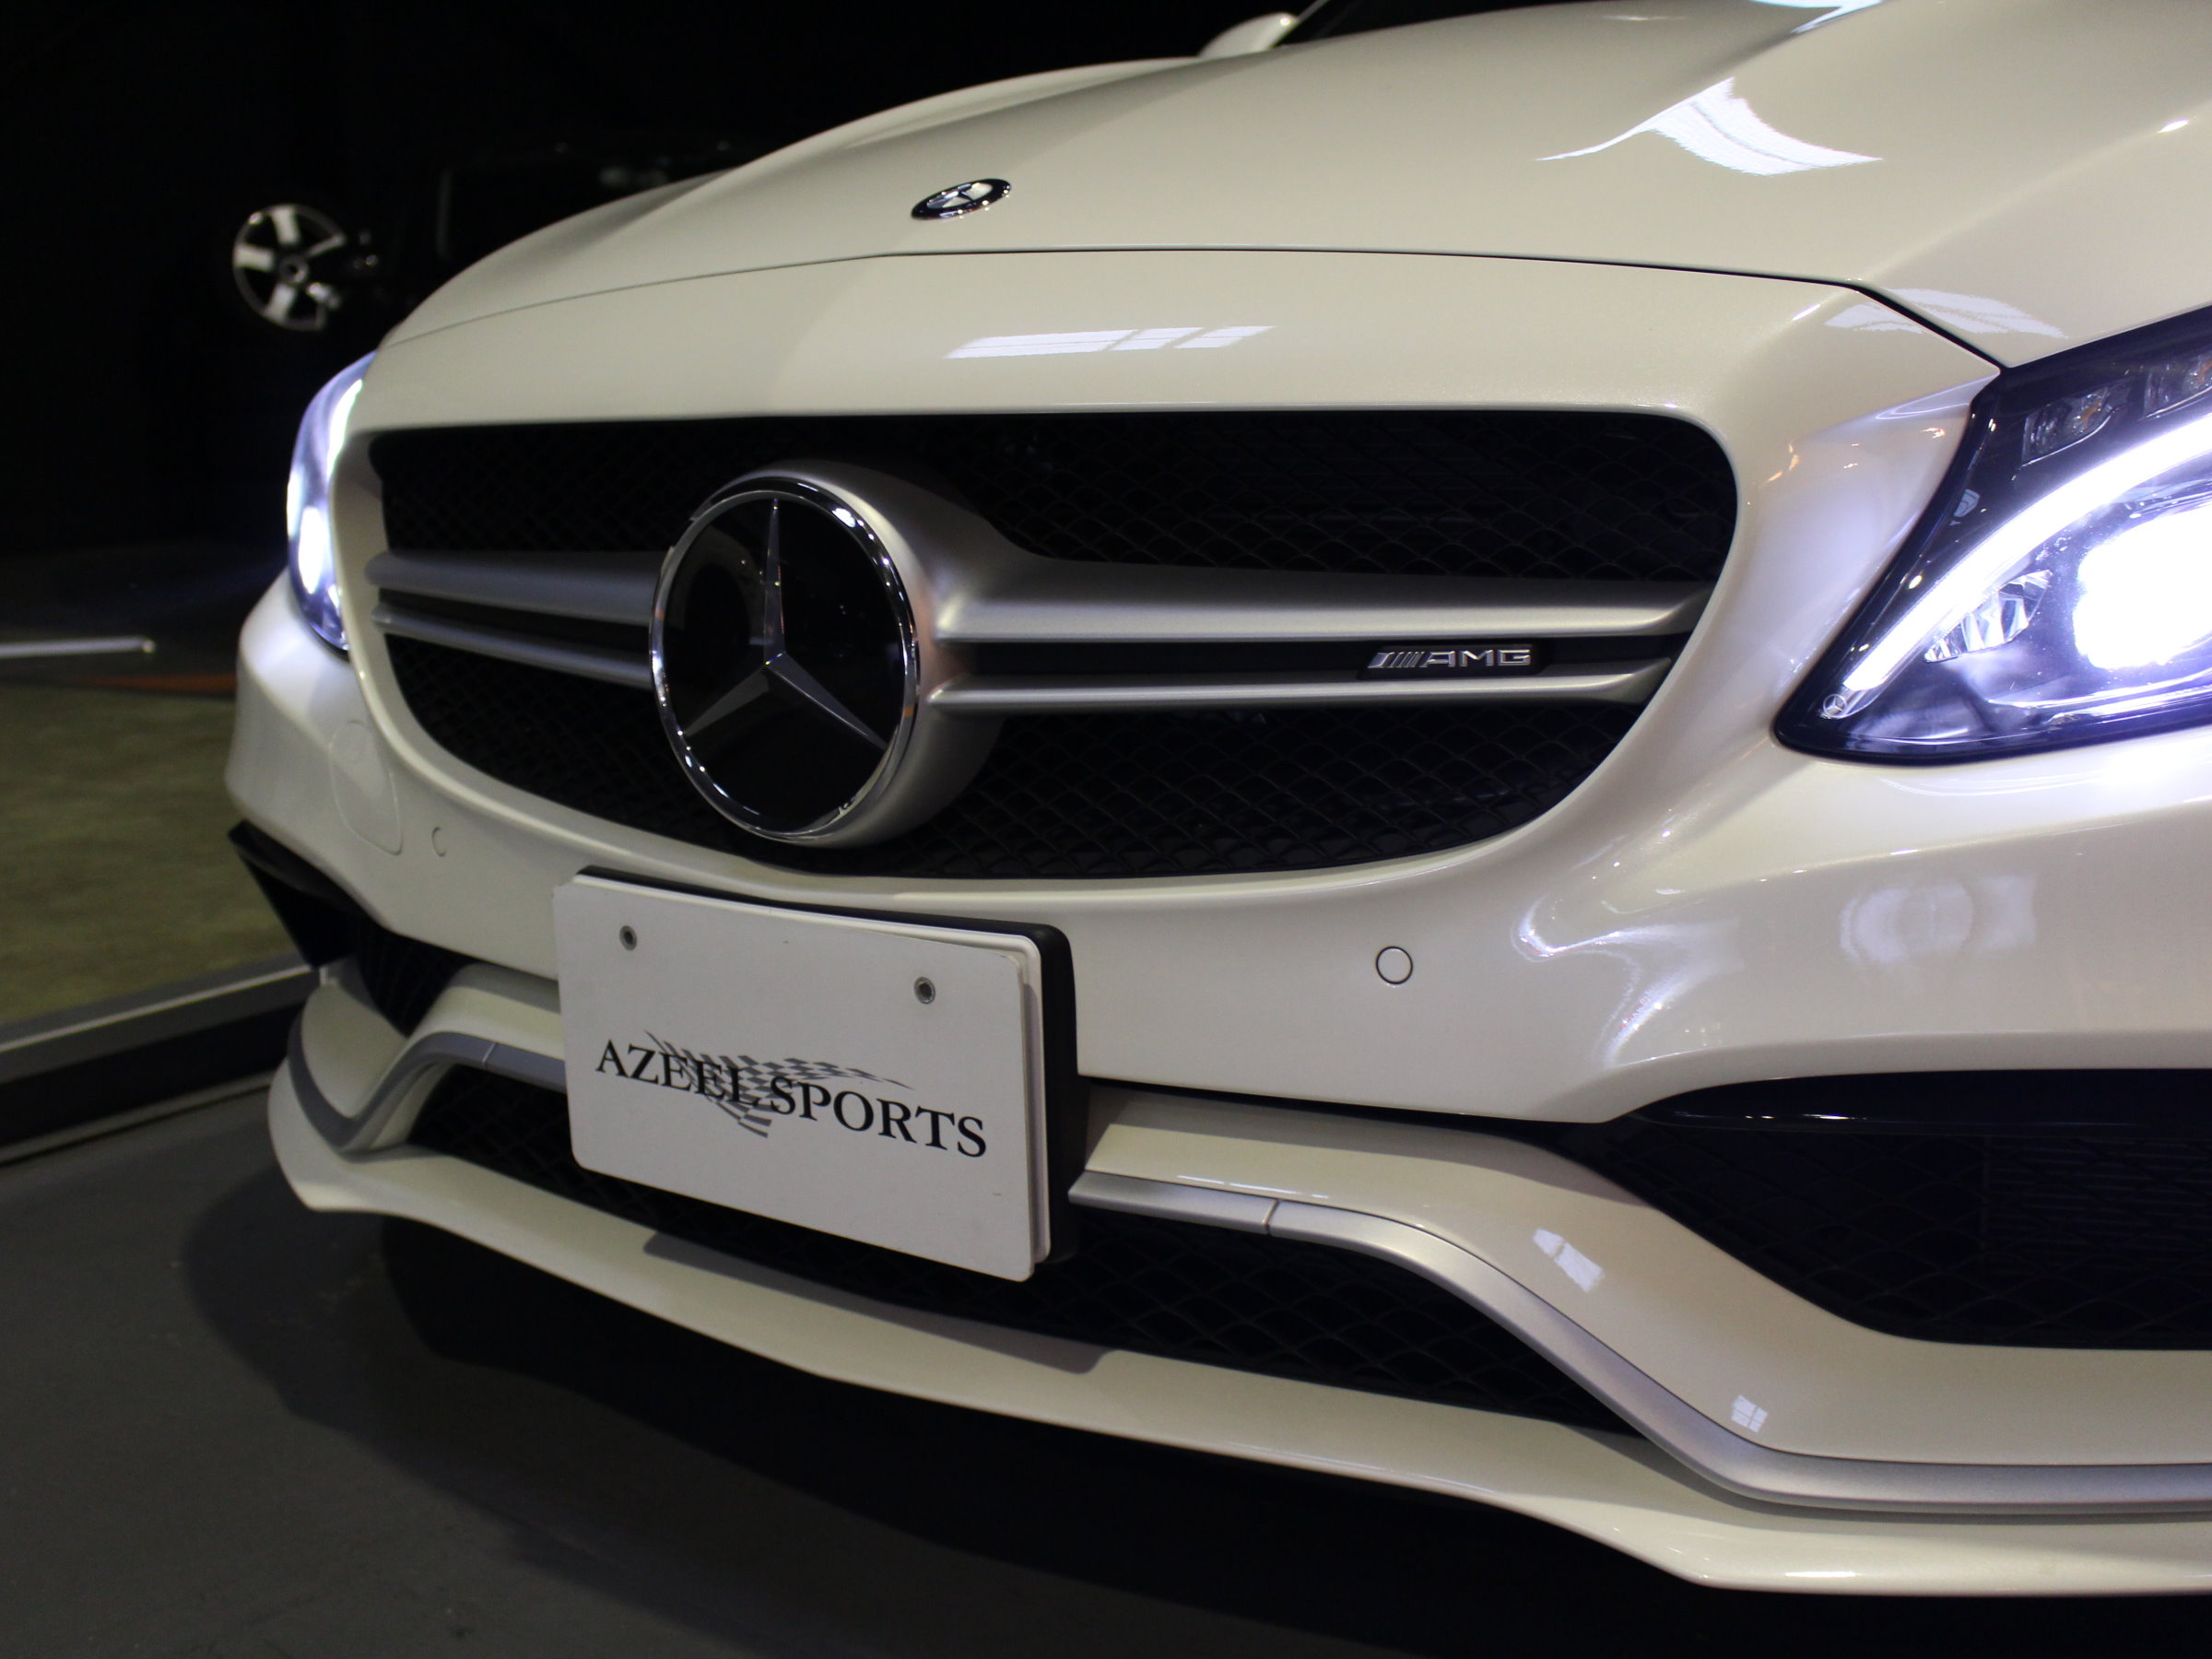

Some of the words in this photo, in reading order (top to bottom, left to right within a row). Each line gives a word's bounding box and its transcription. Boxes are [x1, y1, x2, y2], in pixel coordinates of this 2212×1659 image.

[1419, 649, 1531, 668] AMG
[595, 1040, 759, 1107] AZEEL
[770, 1076, 987, 1159] SPORTS
